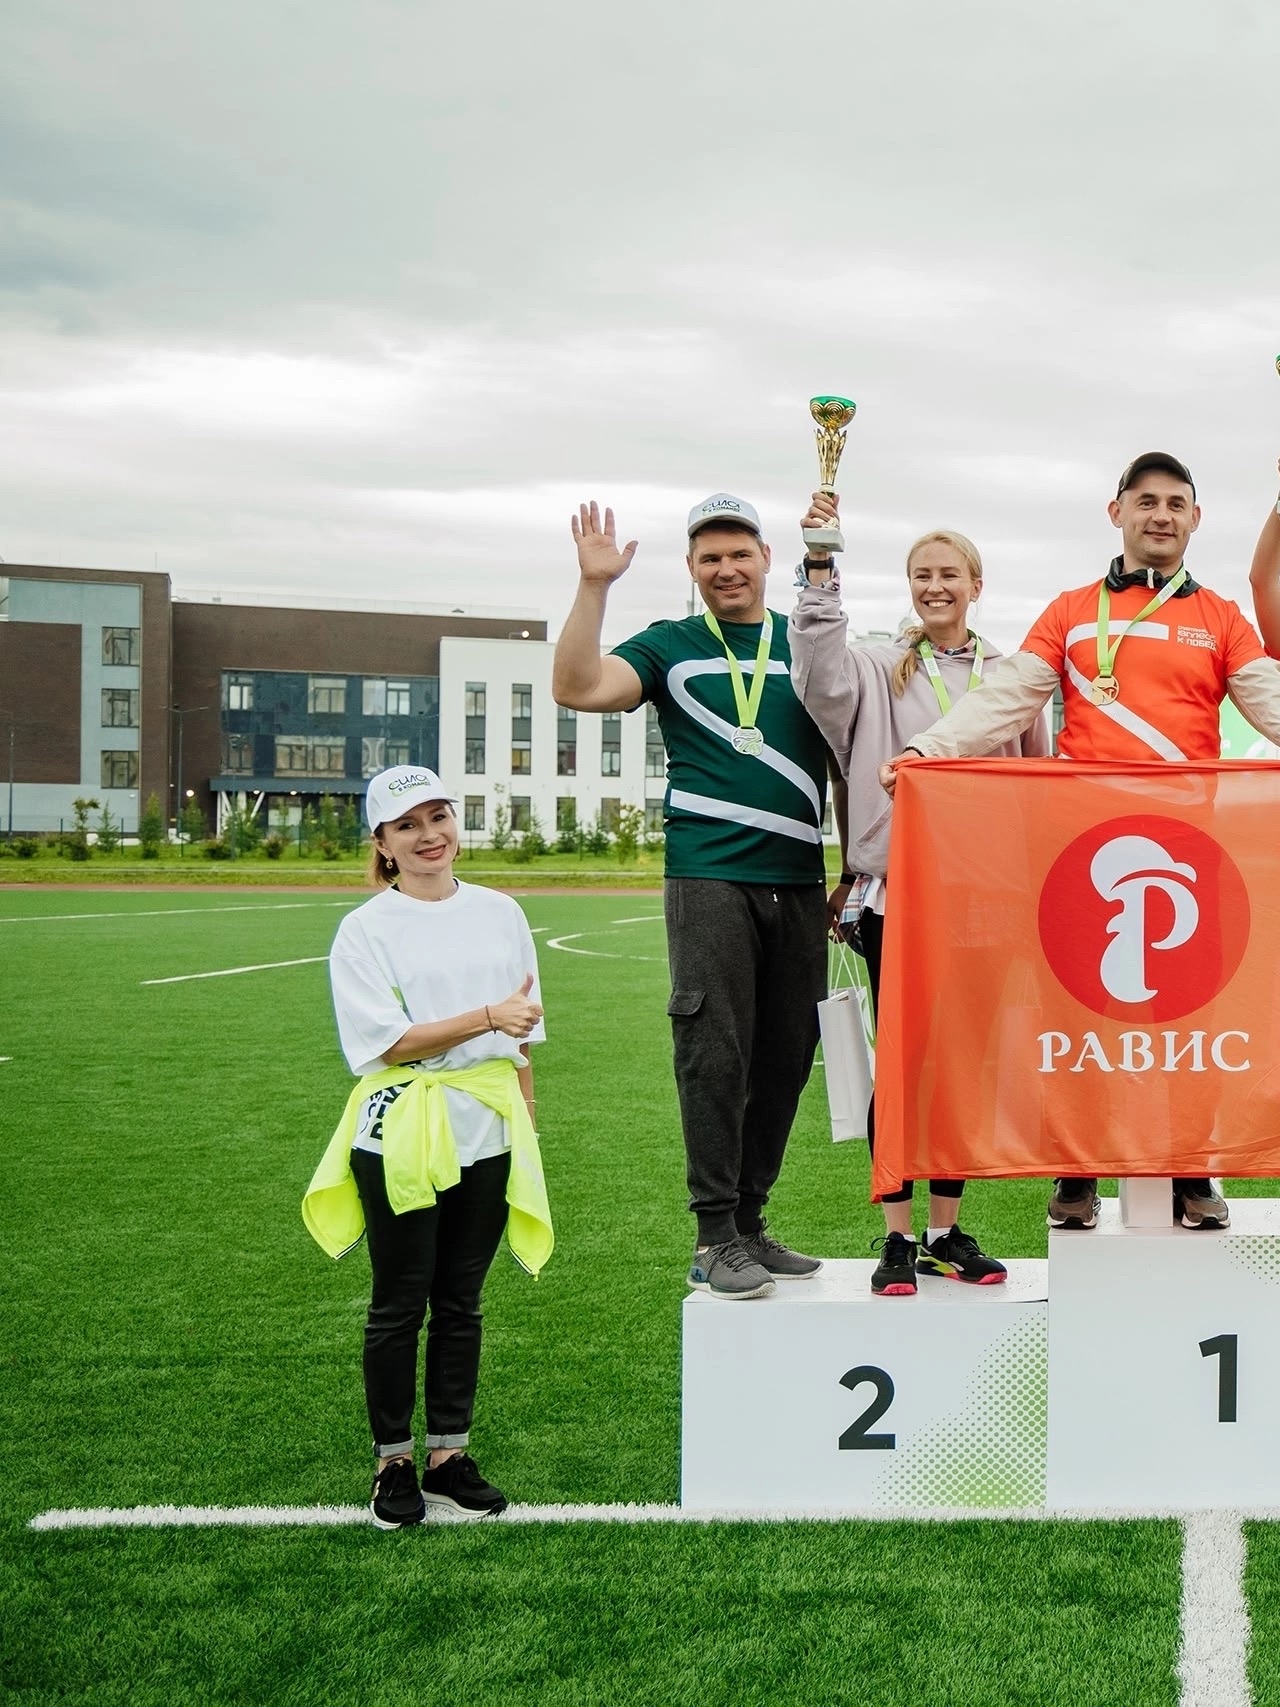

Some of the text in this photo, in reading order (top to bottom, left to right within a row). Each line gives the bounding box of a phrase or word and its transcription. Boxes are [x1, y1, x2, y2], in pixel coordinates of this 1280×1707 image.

[1037, 1030, 1251, 1073] РАВИС
[838, 1365, 896, 1450] 2
[1199, 1335, 1237, 1422] 1
